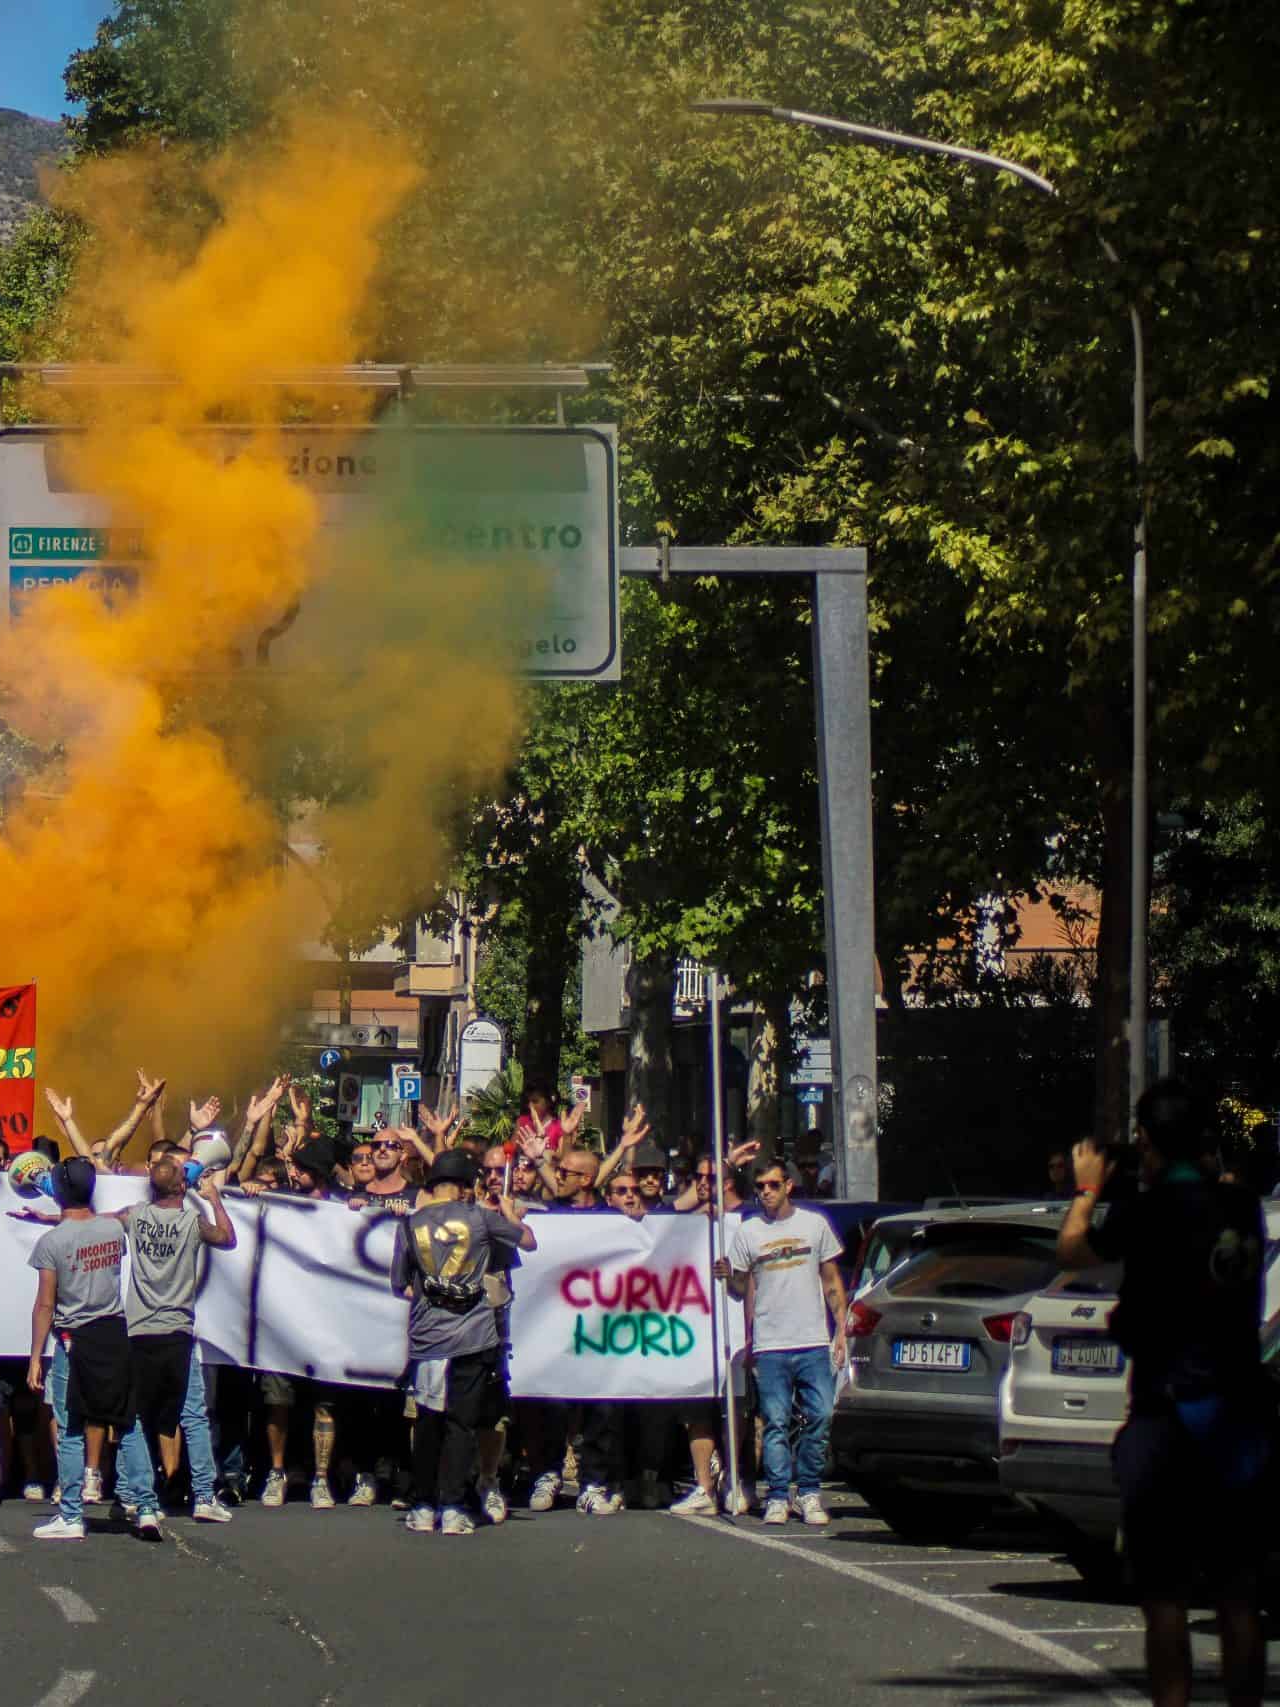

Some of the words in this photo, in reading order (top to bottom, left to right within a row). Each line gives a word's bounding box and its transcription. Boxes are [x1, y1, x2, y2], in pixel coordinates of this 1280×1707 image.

[404, 1080, 416, 1097] P
[136, 1218, 180, 1238] PERUGIA
[135, 1237, 176, 1257] MERDA
[559, 1264, 710, 1315] CURVA
[573, 1312, 696, 1358] NORD
